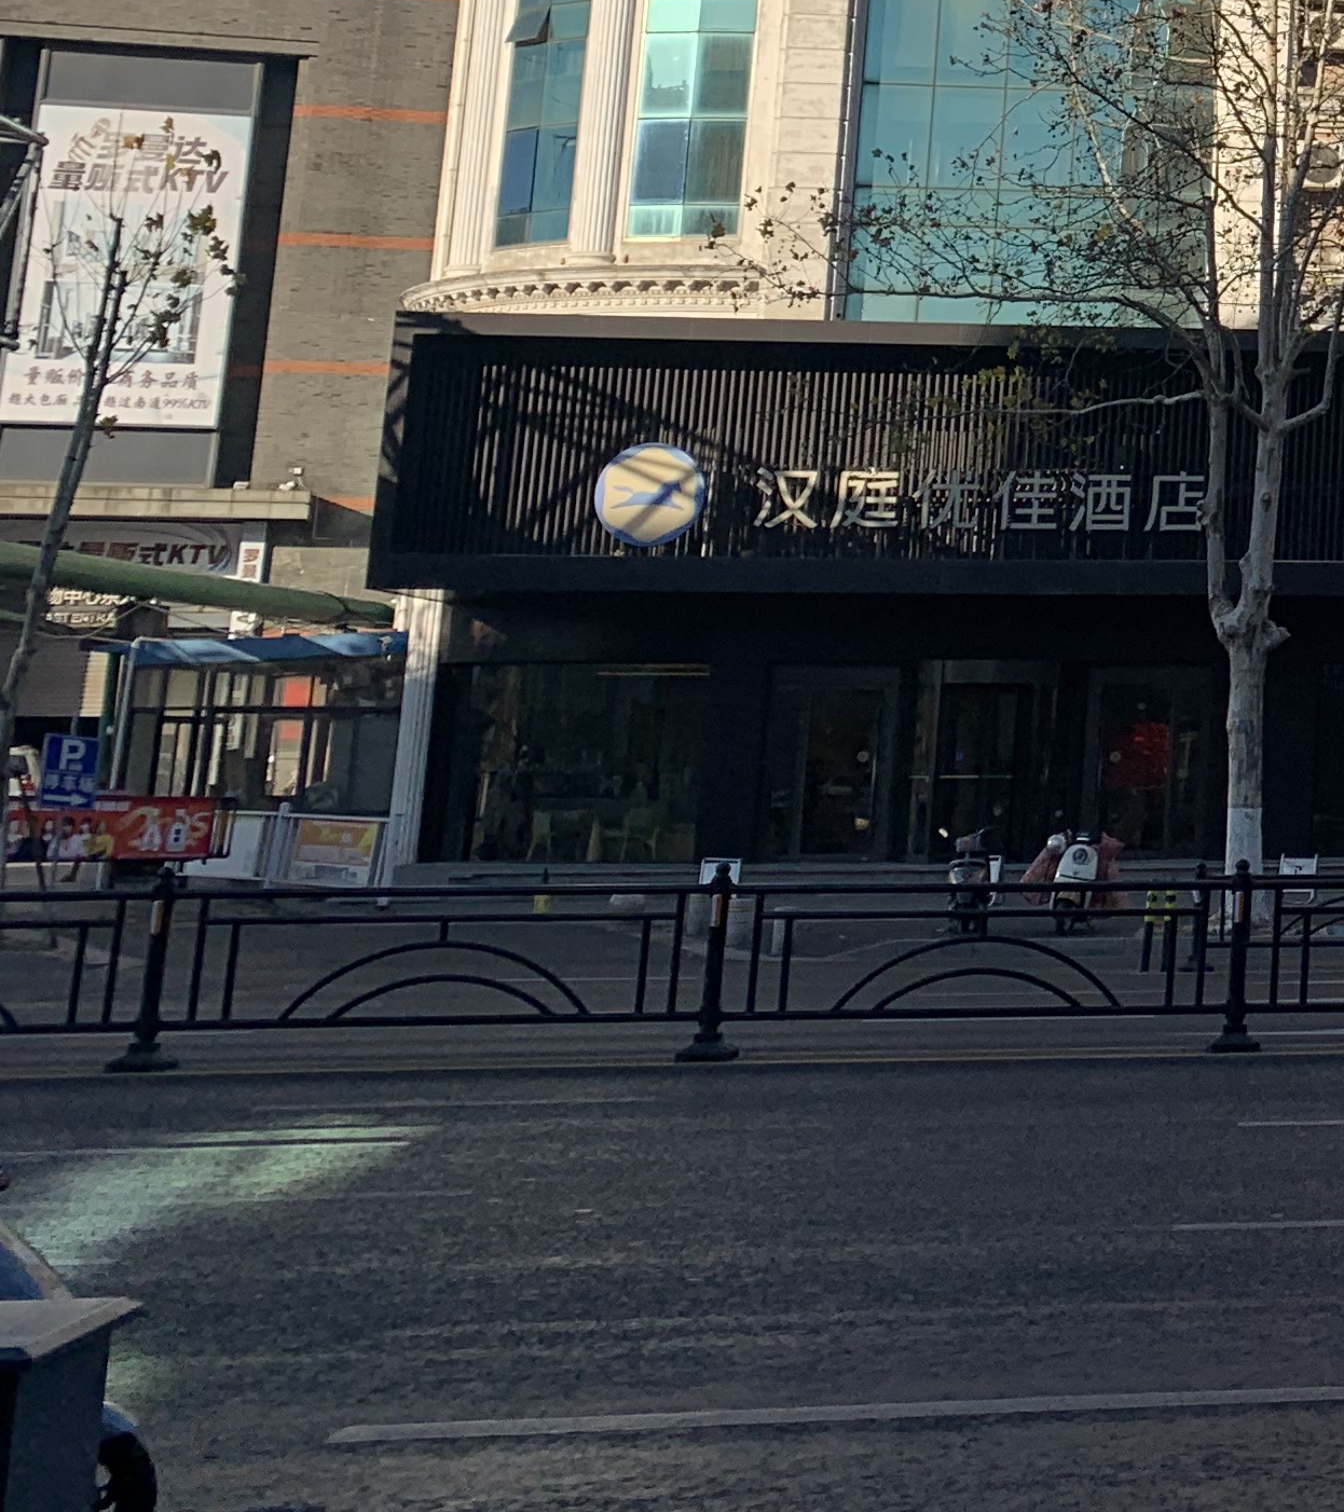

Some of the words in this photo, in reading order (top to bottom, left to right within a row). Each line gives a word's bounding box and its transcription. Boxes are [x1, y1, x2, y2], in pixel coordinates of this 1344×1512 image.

[755, 466, 1207, 532] 汉庭优佳酒店
[58, 738, 87, 770] P
